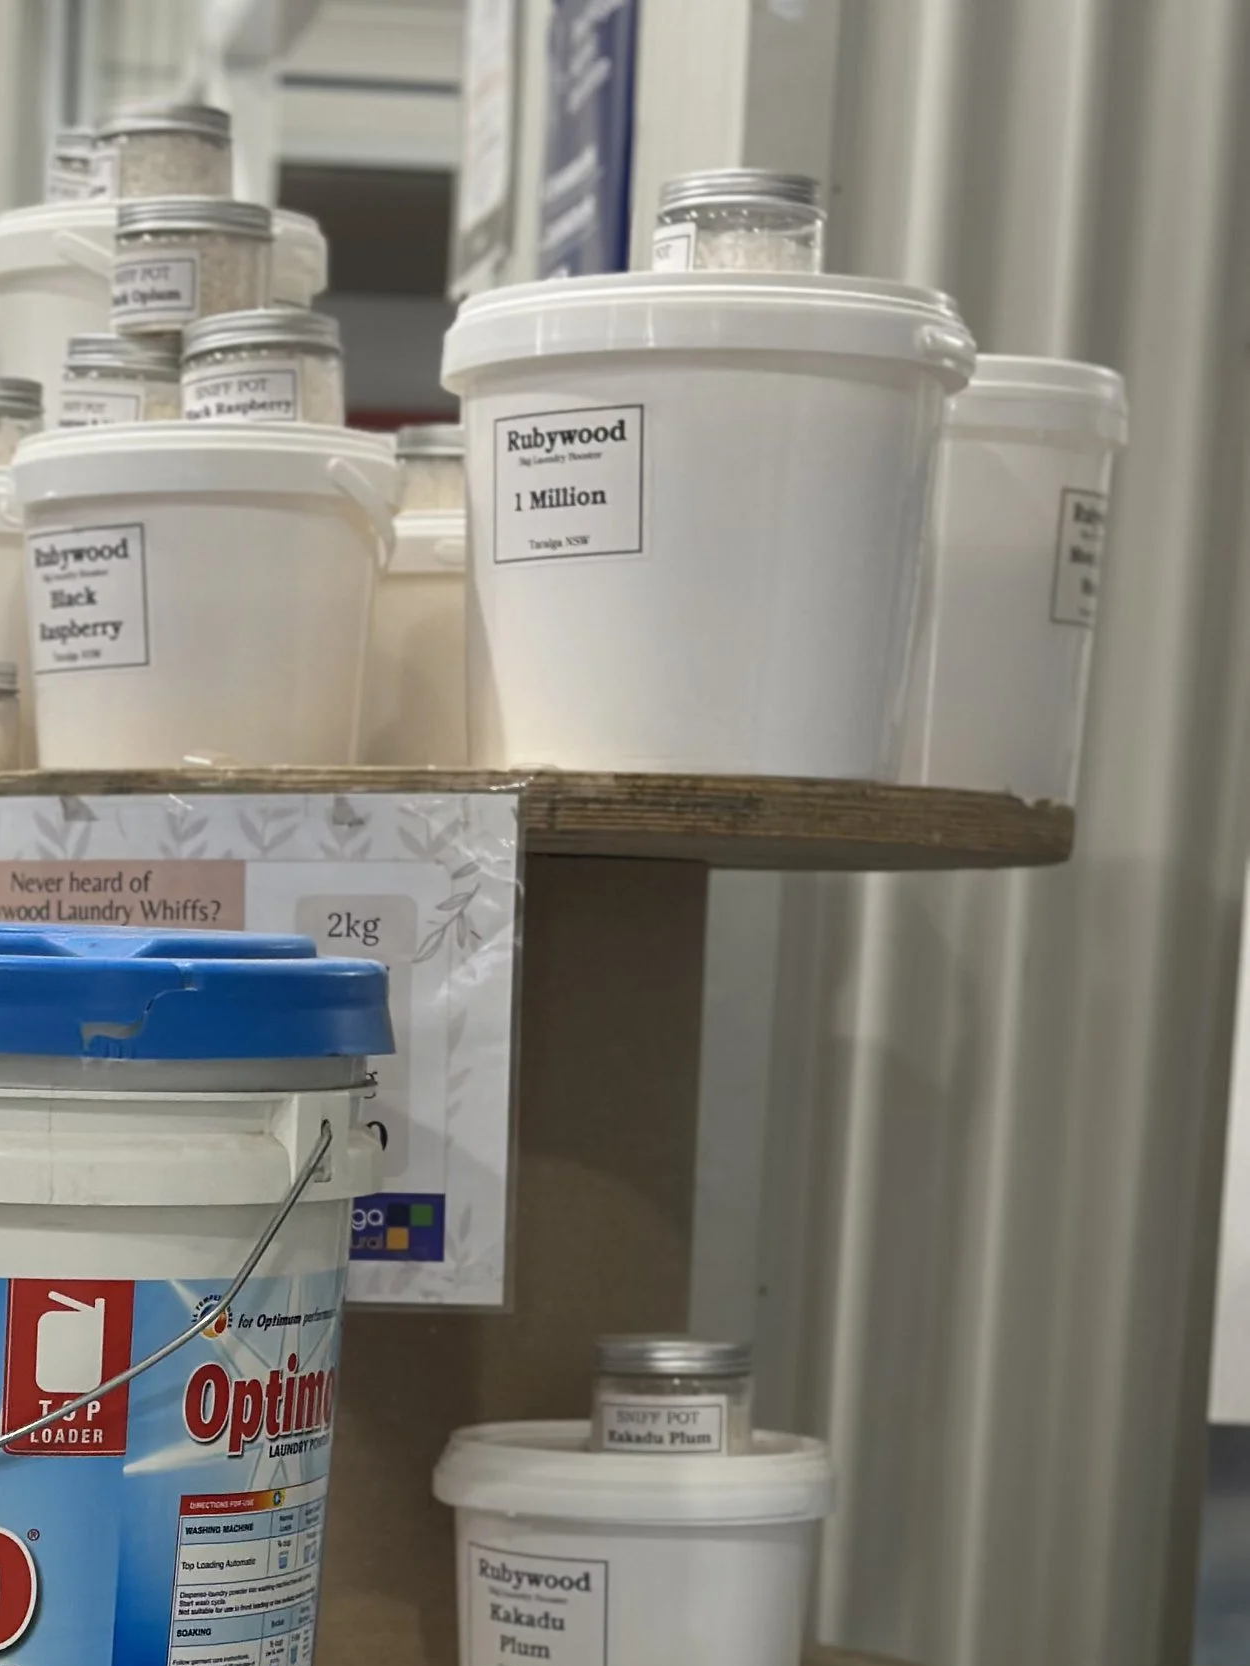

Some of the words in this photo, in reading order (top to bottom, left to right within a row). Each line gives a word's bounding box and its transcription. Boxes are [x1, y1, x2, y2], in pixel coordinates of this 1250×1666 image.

[507, 419, 627, 453] Rubywood
[514, 493, 522, 512] 1
[529, 486, 607, 510] Million
[11, 871, 64, 893] Never
[69, 871, 123, 893] heard
[130, 870, 153, 893] of
[57, 900, 134, 926] Laundry
[140, 899, 222, 923] Whiffs?
[327, 912, 381, 947] 2kg
[238, 1313, 254, 1329] for
[256, 1312, 303, 1331] Optimum
[616, 1410, 662, 1425] SNIFF
[667, 1410, 701, 1425] POT
[30, 1428, 104, 1446] LOADER
[268, 1437, 308, 1459] LAUNDRY
[608, 1429, 664, 1444] Kakadu
[670, 1430, 712, 1445] Plum
[185, 1526, 221, 1535] WASHING
[223, 1522, 255, 1534] MACHINE
[181, 1561, 195, 1571] Top
[196, 1560, 225, 1571] Loading
[225, 1558, 257, 1568] Automatic
[478, 1558, 591, 1592] Rubywood
[490, 1602, 565, 1631] Kakadu
[176, 1627, 212, 1638] SOAKING
[499, 1634, 551, 1659] Plum
